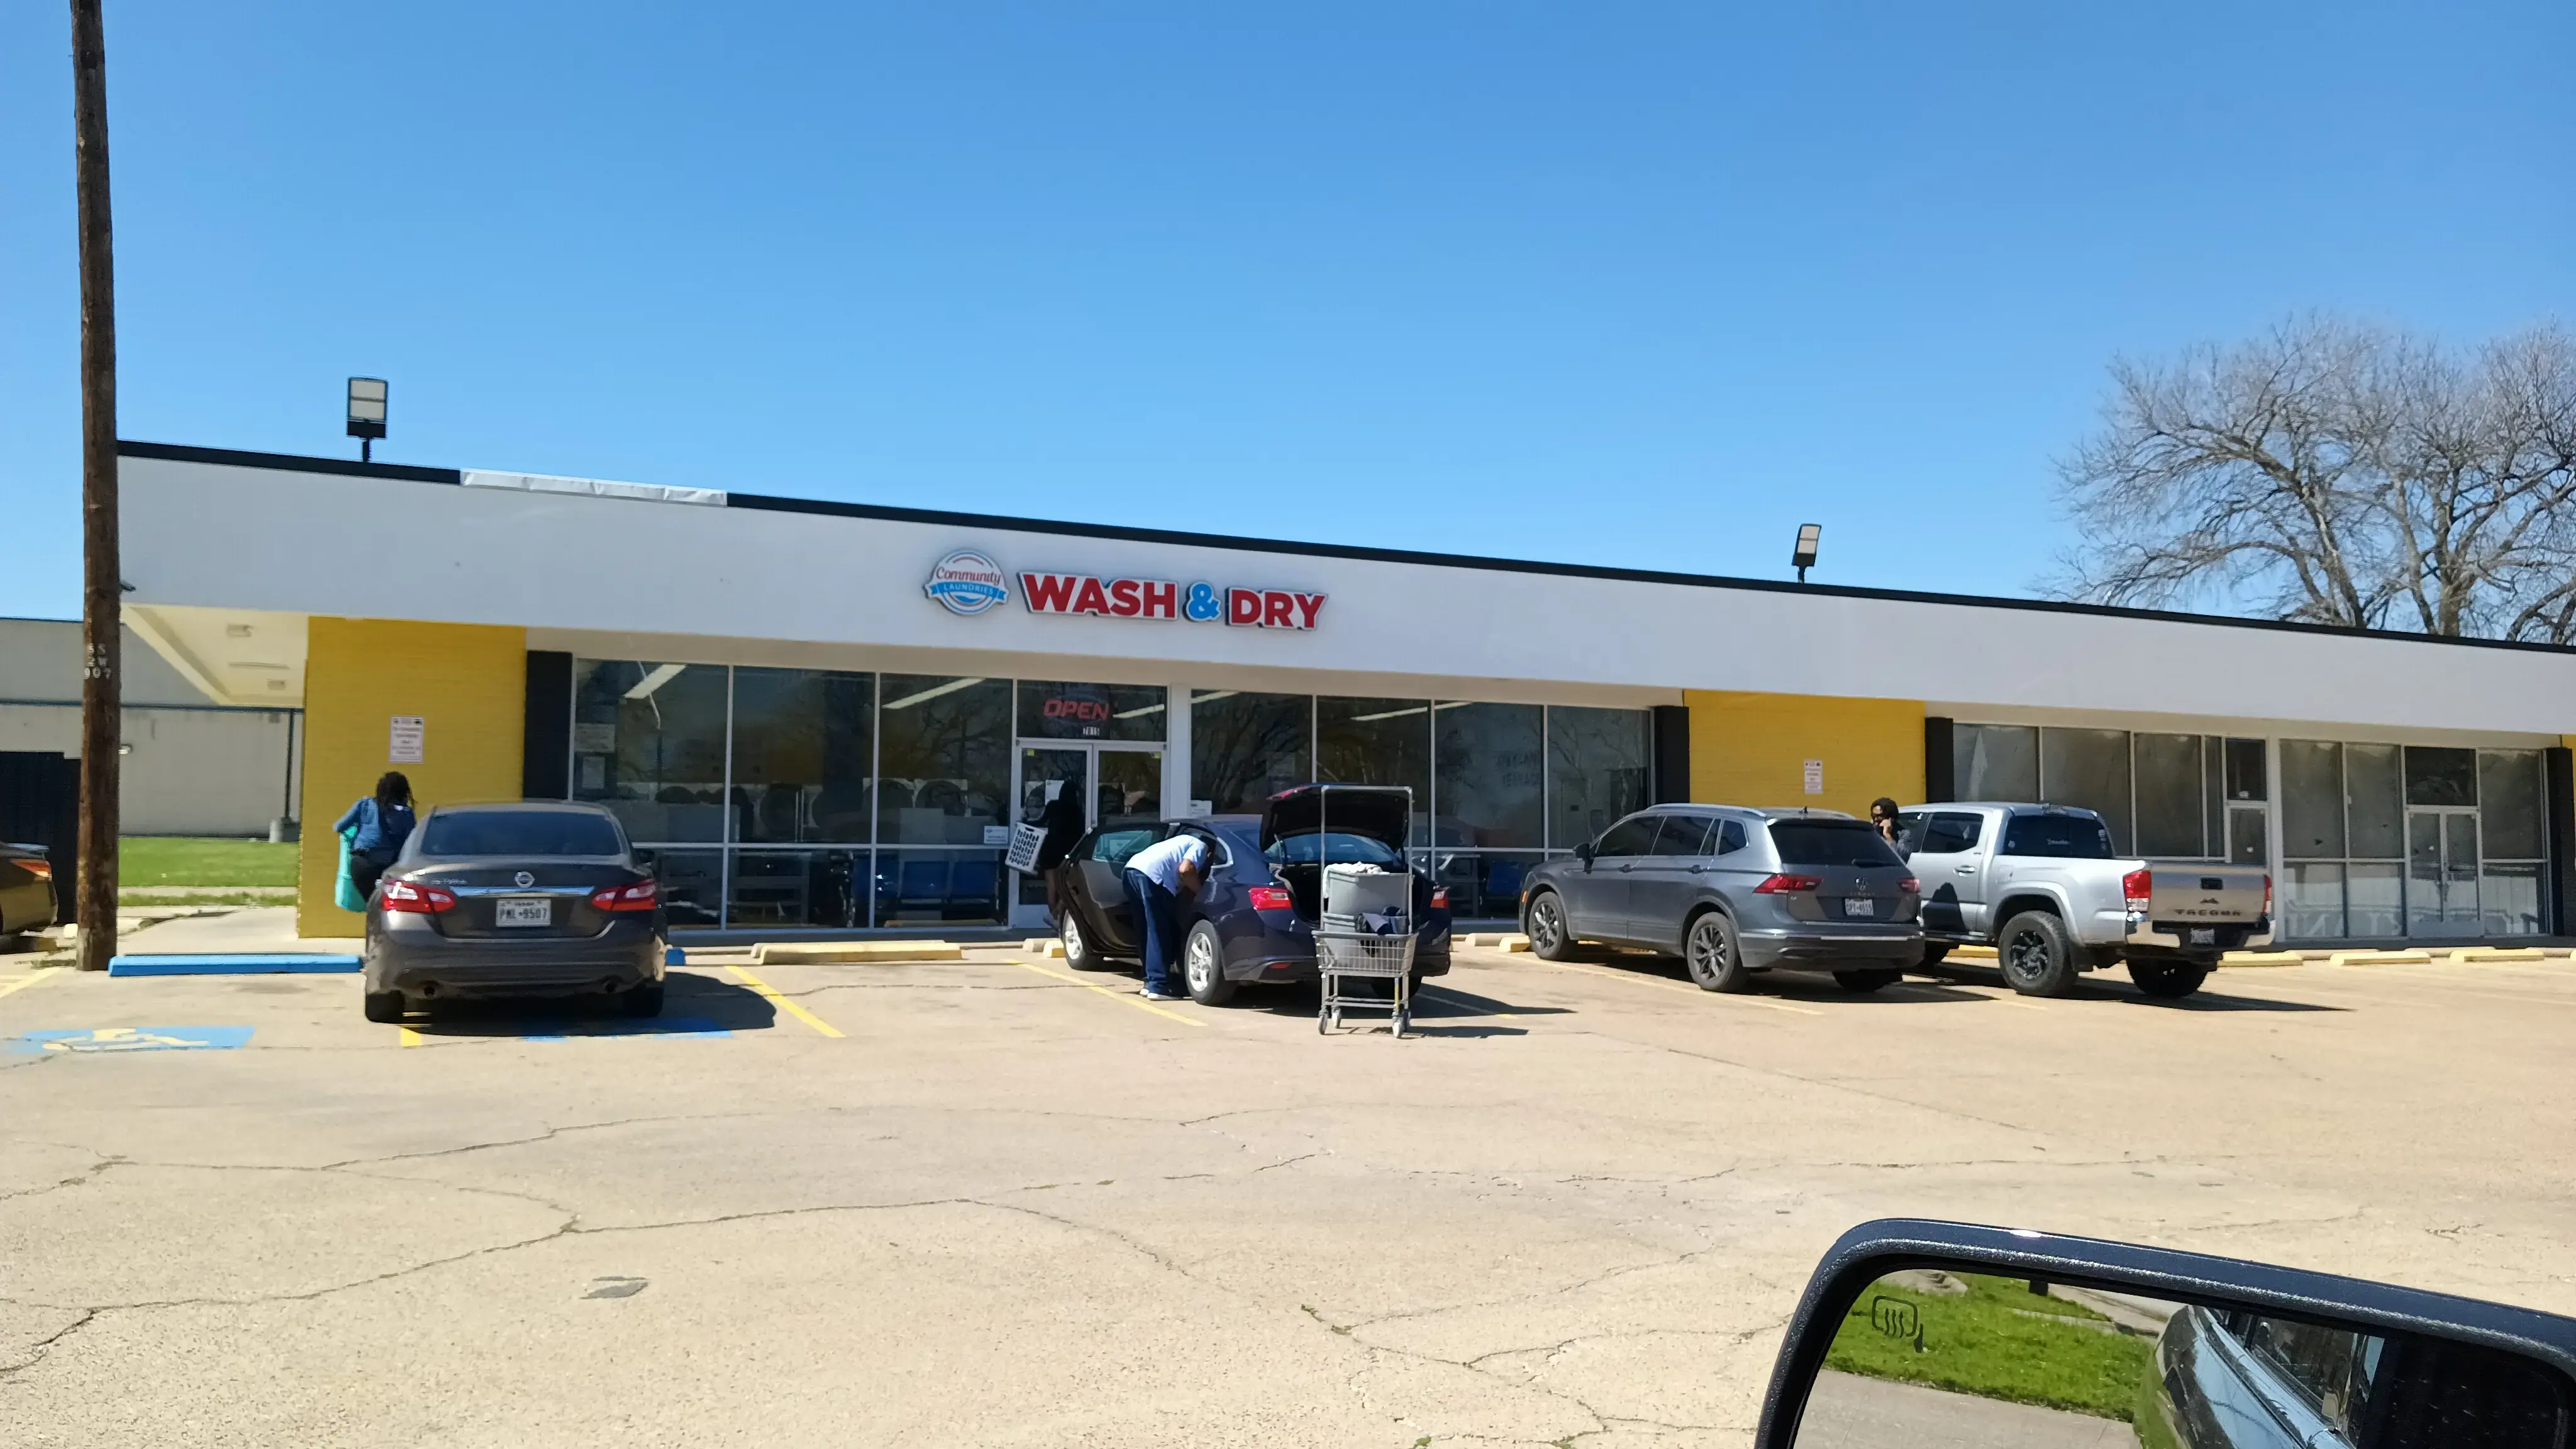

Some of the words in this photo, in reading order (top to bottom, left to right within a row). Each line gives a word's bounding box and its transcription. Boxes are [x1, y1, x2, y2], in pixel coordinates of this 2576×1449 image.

[936, 566, 1001, 586] Community
[943, 583, 994, 595] LAUNDRIES
[1023, 574, 1176, 619] WASH
[1188, 583, 1219, 620] &
[1231, 589, 1326, 629] DRY
[1044, 699, 1109, 720] OPEN
